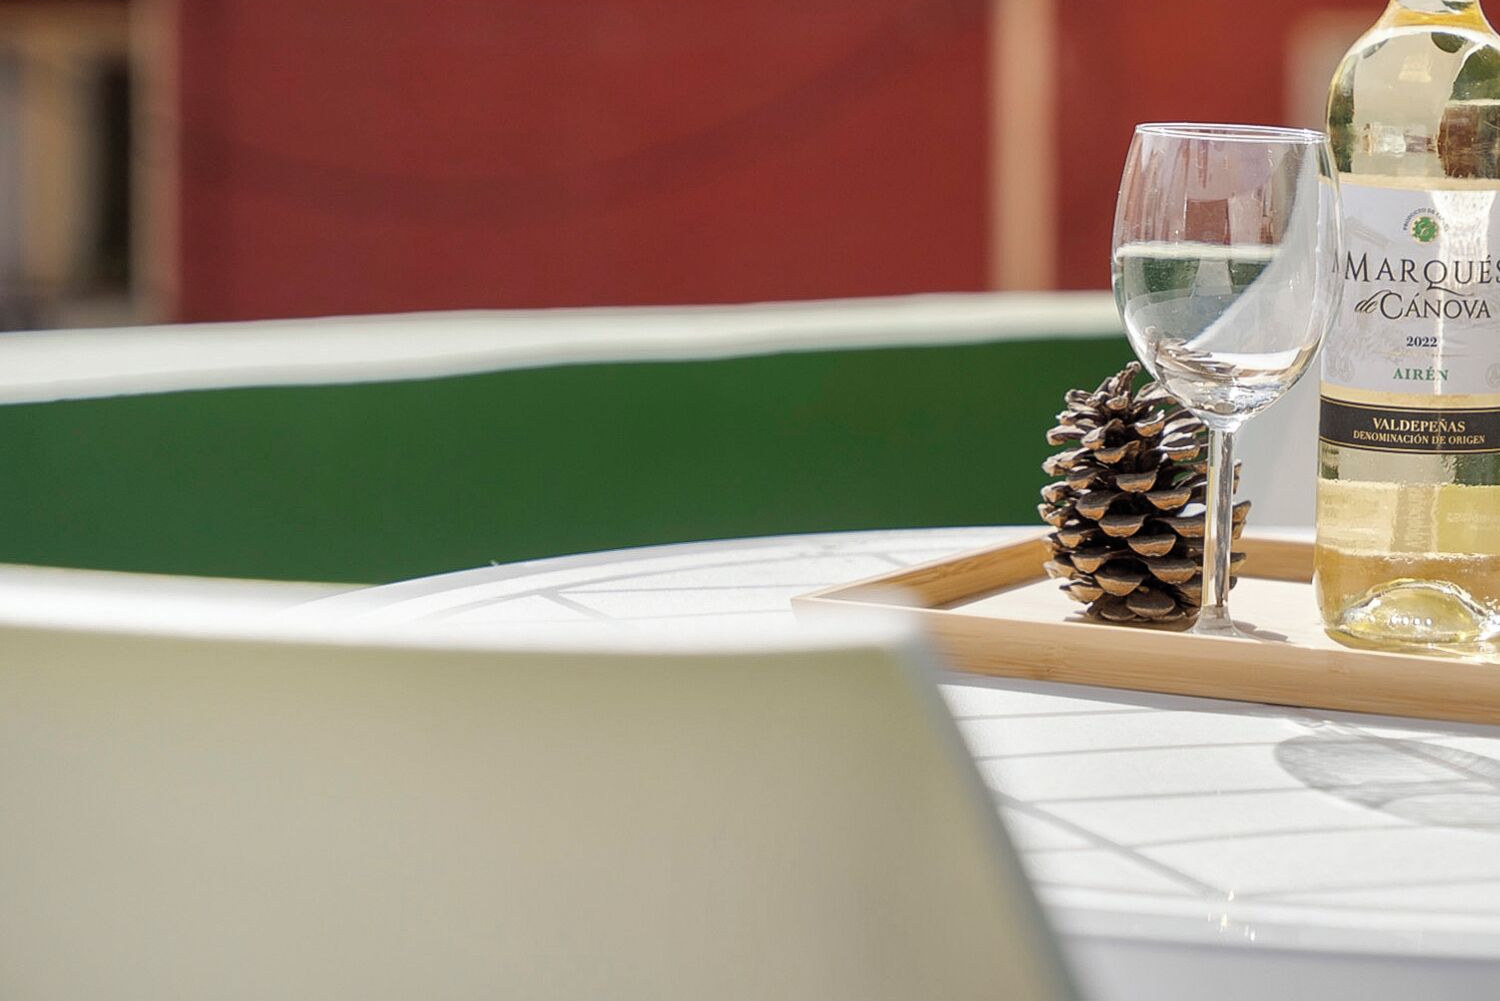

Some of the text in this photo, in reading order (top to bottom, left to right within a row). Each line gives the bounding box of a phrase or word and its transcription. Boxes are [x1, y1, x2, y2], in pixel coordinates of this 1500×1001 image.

[1354, 289, 1492, 320] de CÁNOVA
[1406, 336, 1438, 348] 2022
[1393, 366, 1449, 381] AIRÉN
[1372, 417, 1466, 433] VALDEPEÑAS
[1353, 430, 1486, 445] DENOMINACIÓN DE ORIGEN
